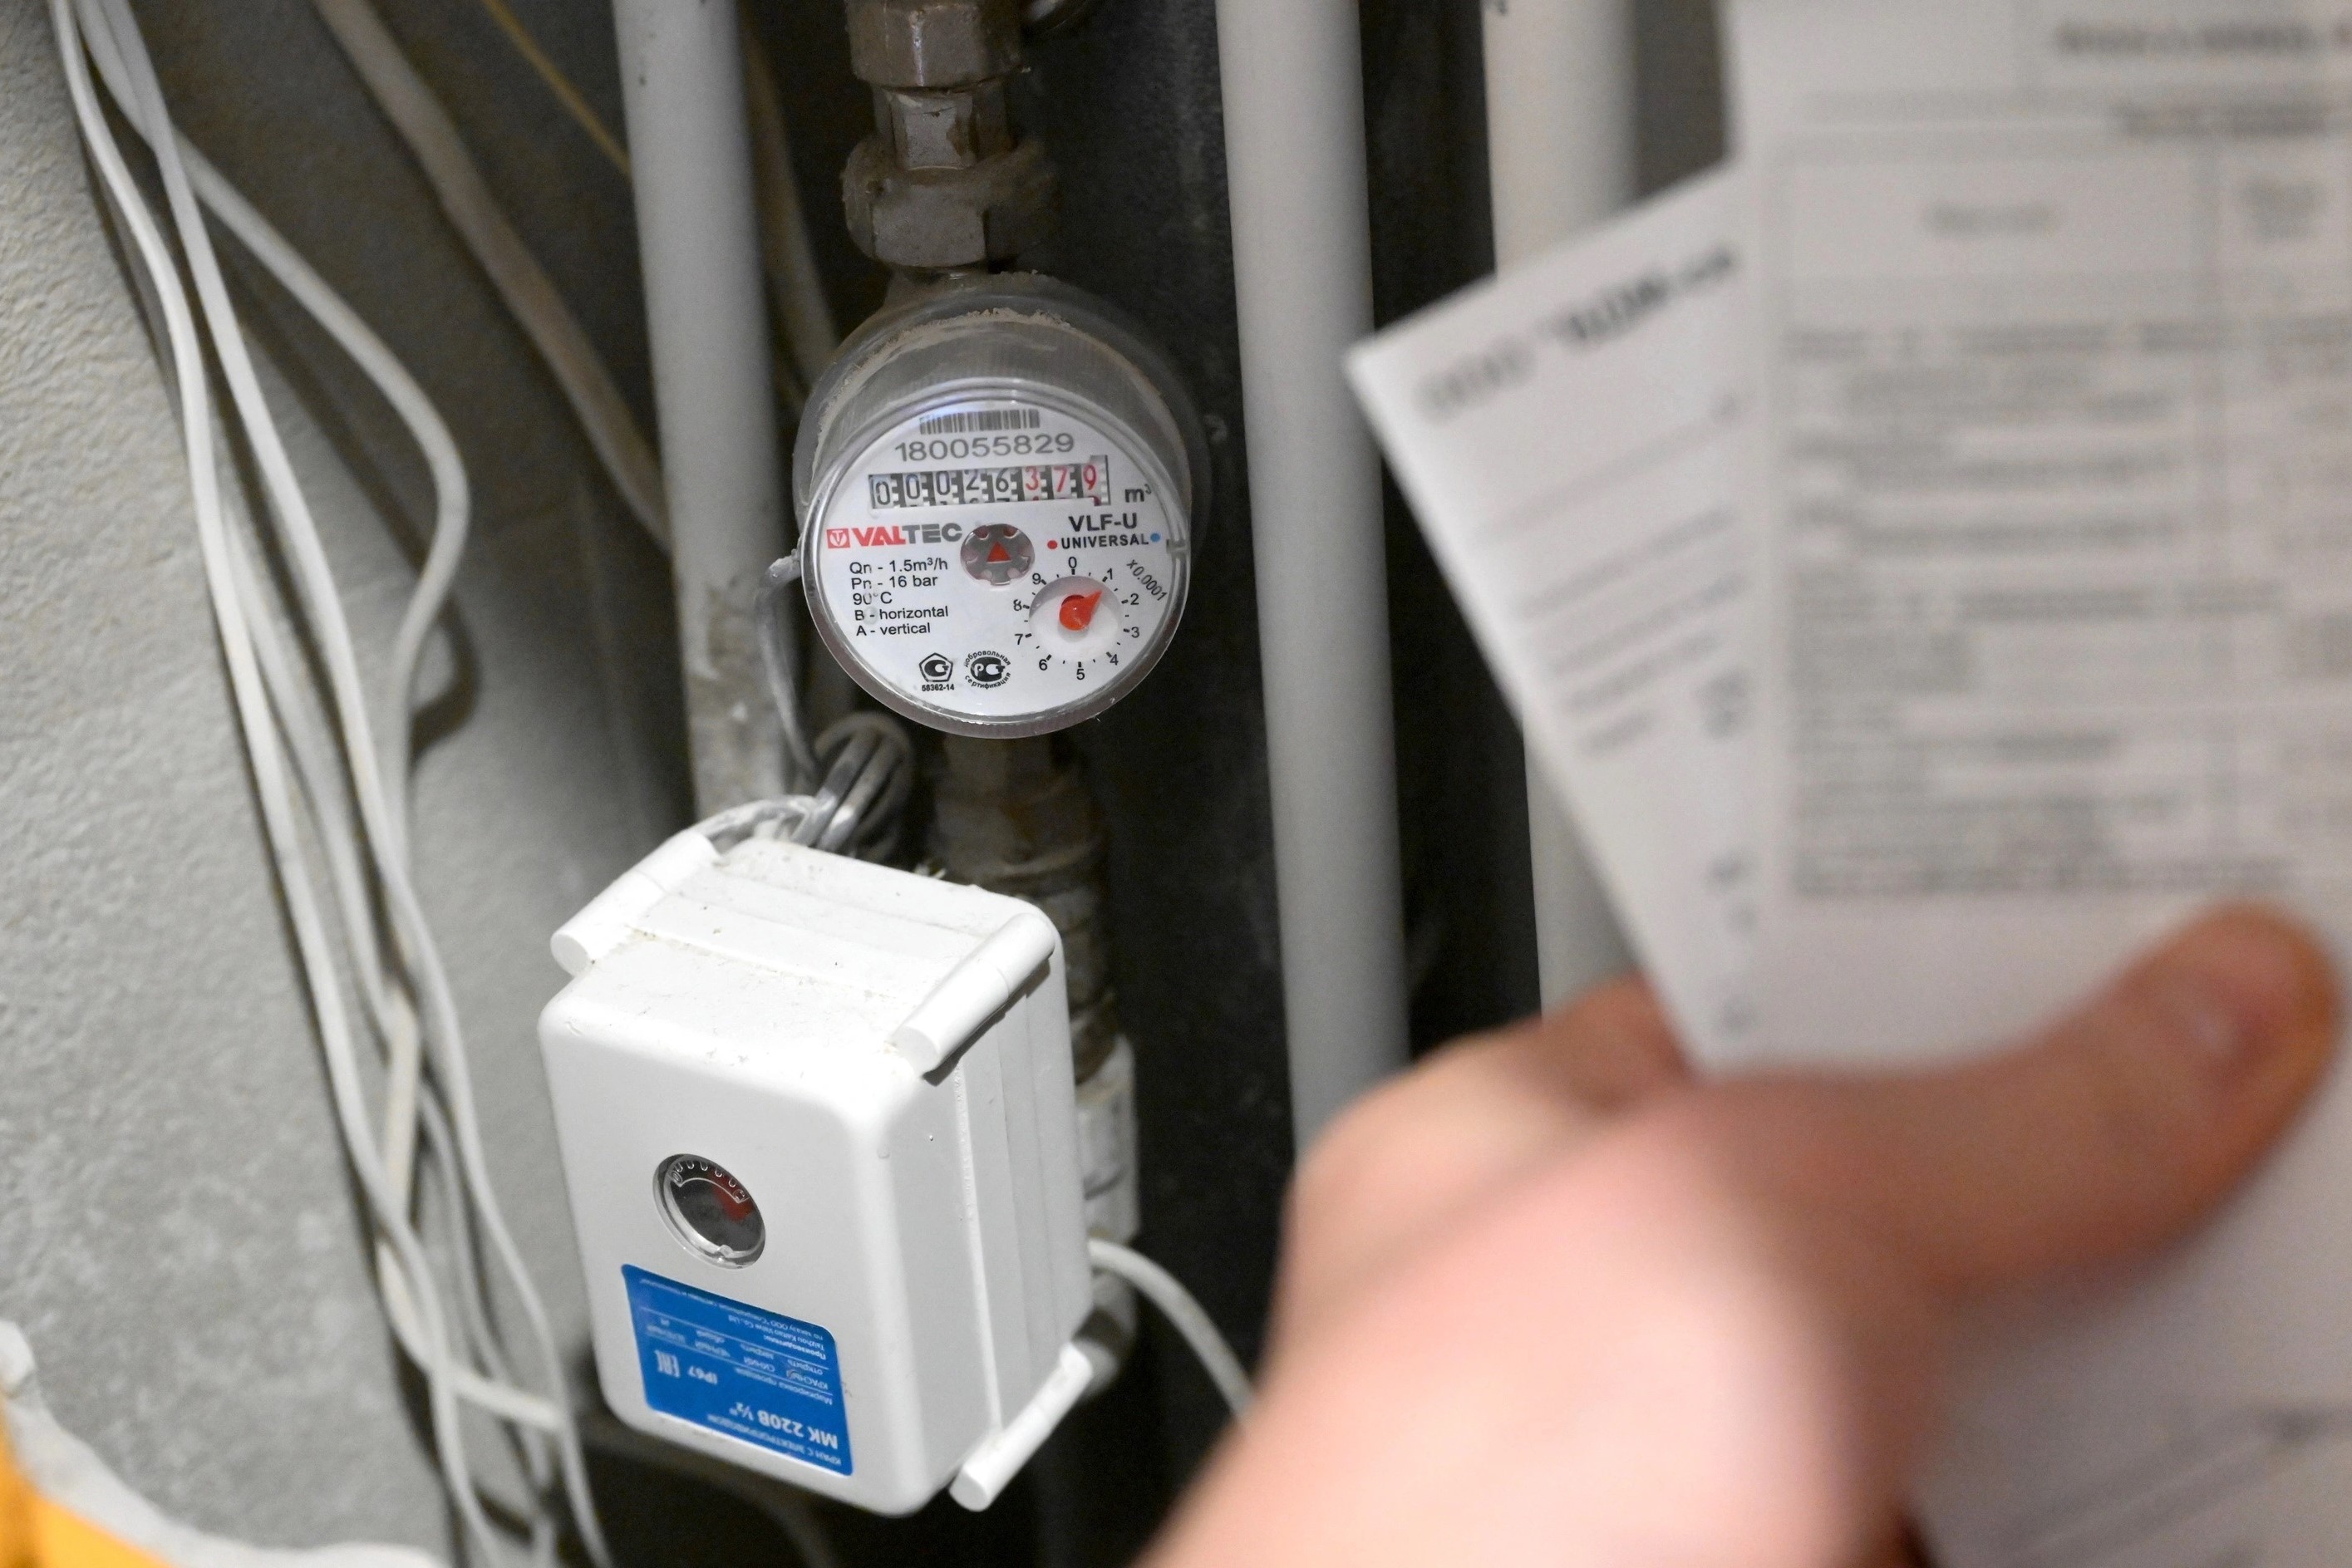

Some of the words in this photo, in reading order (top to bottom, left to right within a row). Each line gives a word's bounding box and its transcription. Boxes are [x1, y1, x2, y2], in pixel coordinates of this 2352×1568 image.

[894, 432, 1075, 462] 180055829
[1068, 513, 1138, 532] VLF-U
[852, 523, 963, 547] VALTEC
[1061, 533, 1149, 549] UNIVERSAL
[849, 562, 872, 574] Qn
[1068, 556, 1077, 568] 0
[1031, 573, 1041, 585] 9
[1106, 568, 1113, 580] 1
[1126, 559, 1168, 602] x0.0001
[851, 577, 872, 590] Pn
[889, 575, 908, 588] 16
[913, 575, 938, 587] bar
[1013, 599, 1022, 612] 8
[1129, 593, 1139, 606] 2
[854, 609, 864, 621] B
[879, 606, 948, 620] horizontal
[856, 625, 867, 637] A
[879, 622, 931, 636] vertical
[1131, 627, 1140, 638] 3
[1015, 633, 1024, 646] 7
[1039, 659, 1049, 671] 6
[1110, 653, 1119, 666] 4
[1076, 668, 1085, 681] 5
[922, 683, 955, 692] 58362-14
